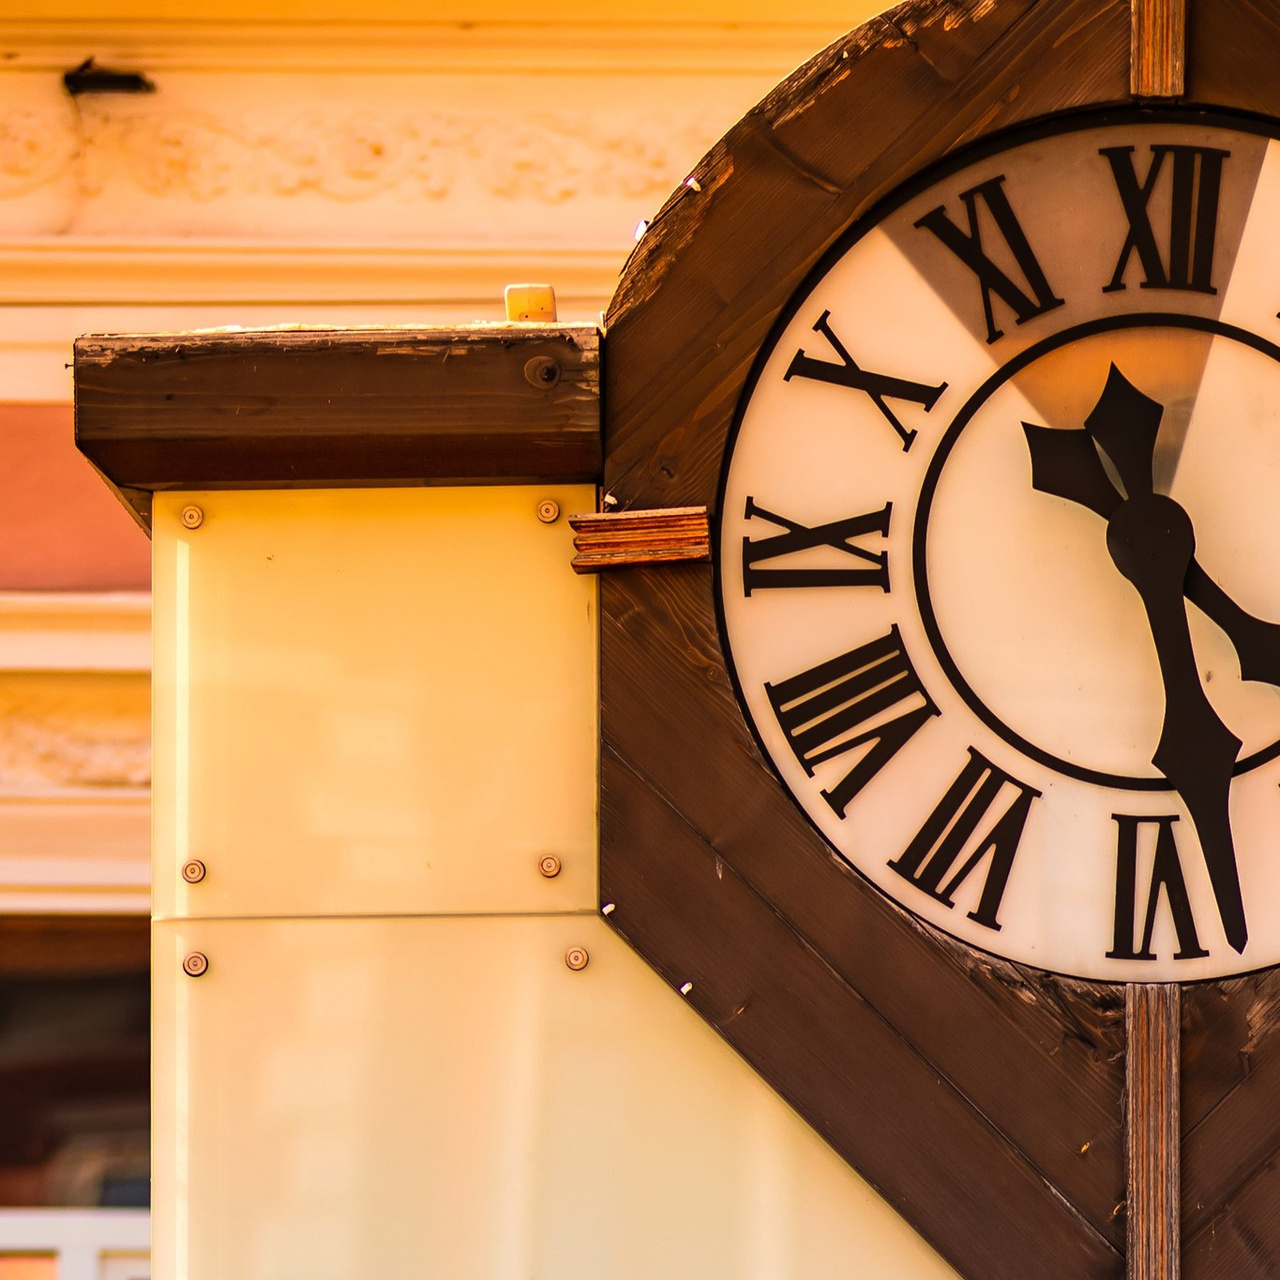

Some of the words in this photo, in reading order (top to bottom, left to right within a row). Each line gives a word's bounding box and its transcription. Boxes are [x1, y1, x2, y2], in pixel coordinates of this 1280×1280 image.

[913, 174, 1065, 344] XI
[1098, 144, 1231, 295] XII
[784, 310, 948, 452] X
[743, 496, 893, 597] IX
[887, 746, 1042, 931] VII
[1106, 814, 1209, 960] VI
